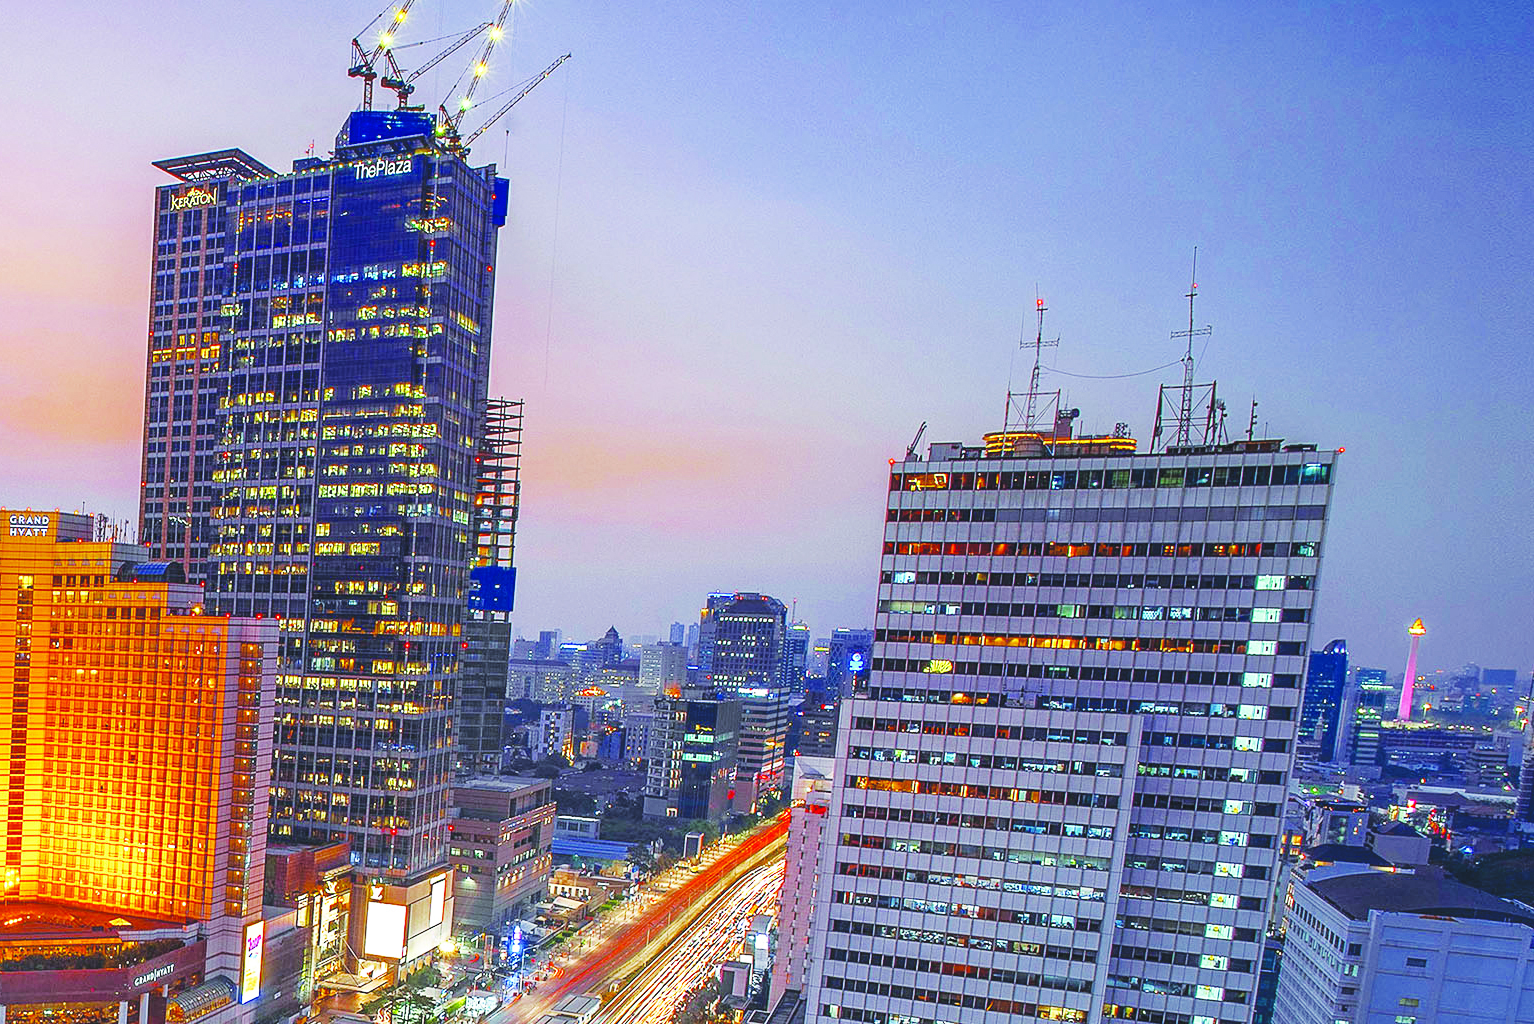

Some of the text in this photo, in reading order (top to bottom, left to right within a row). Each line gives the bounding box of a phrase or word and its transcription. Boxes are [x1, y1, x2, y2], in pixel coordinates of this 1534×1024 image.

[170, 187, 218, 211] KERATON
[10, 515, 49, 525] GRAND
[10, 528, 47, 537] HYATT
